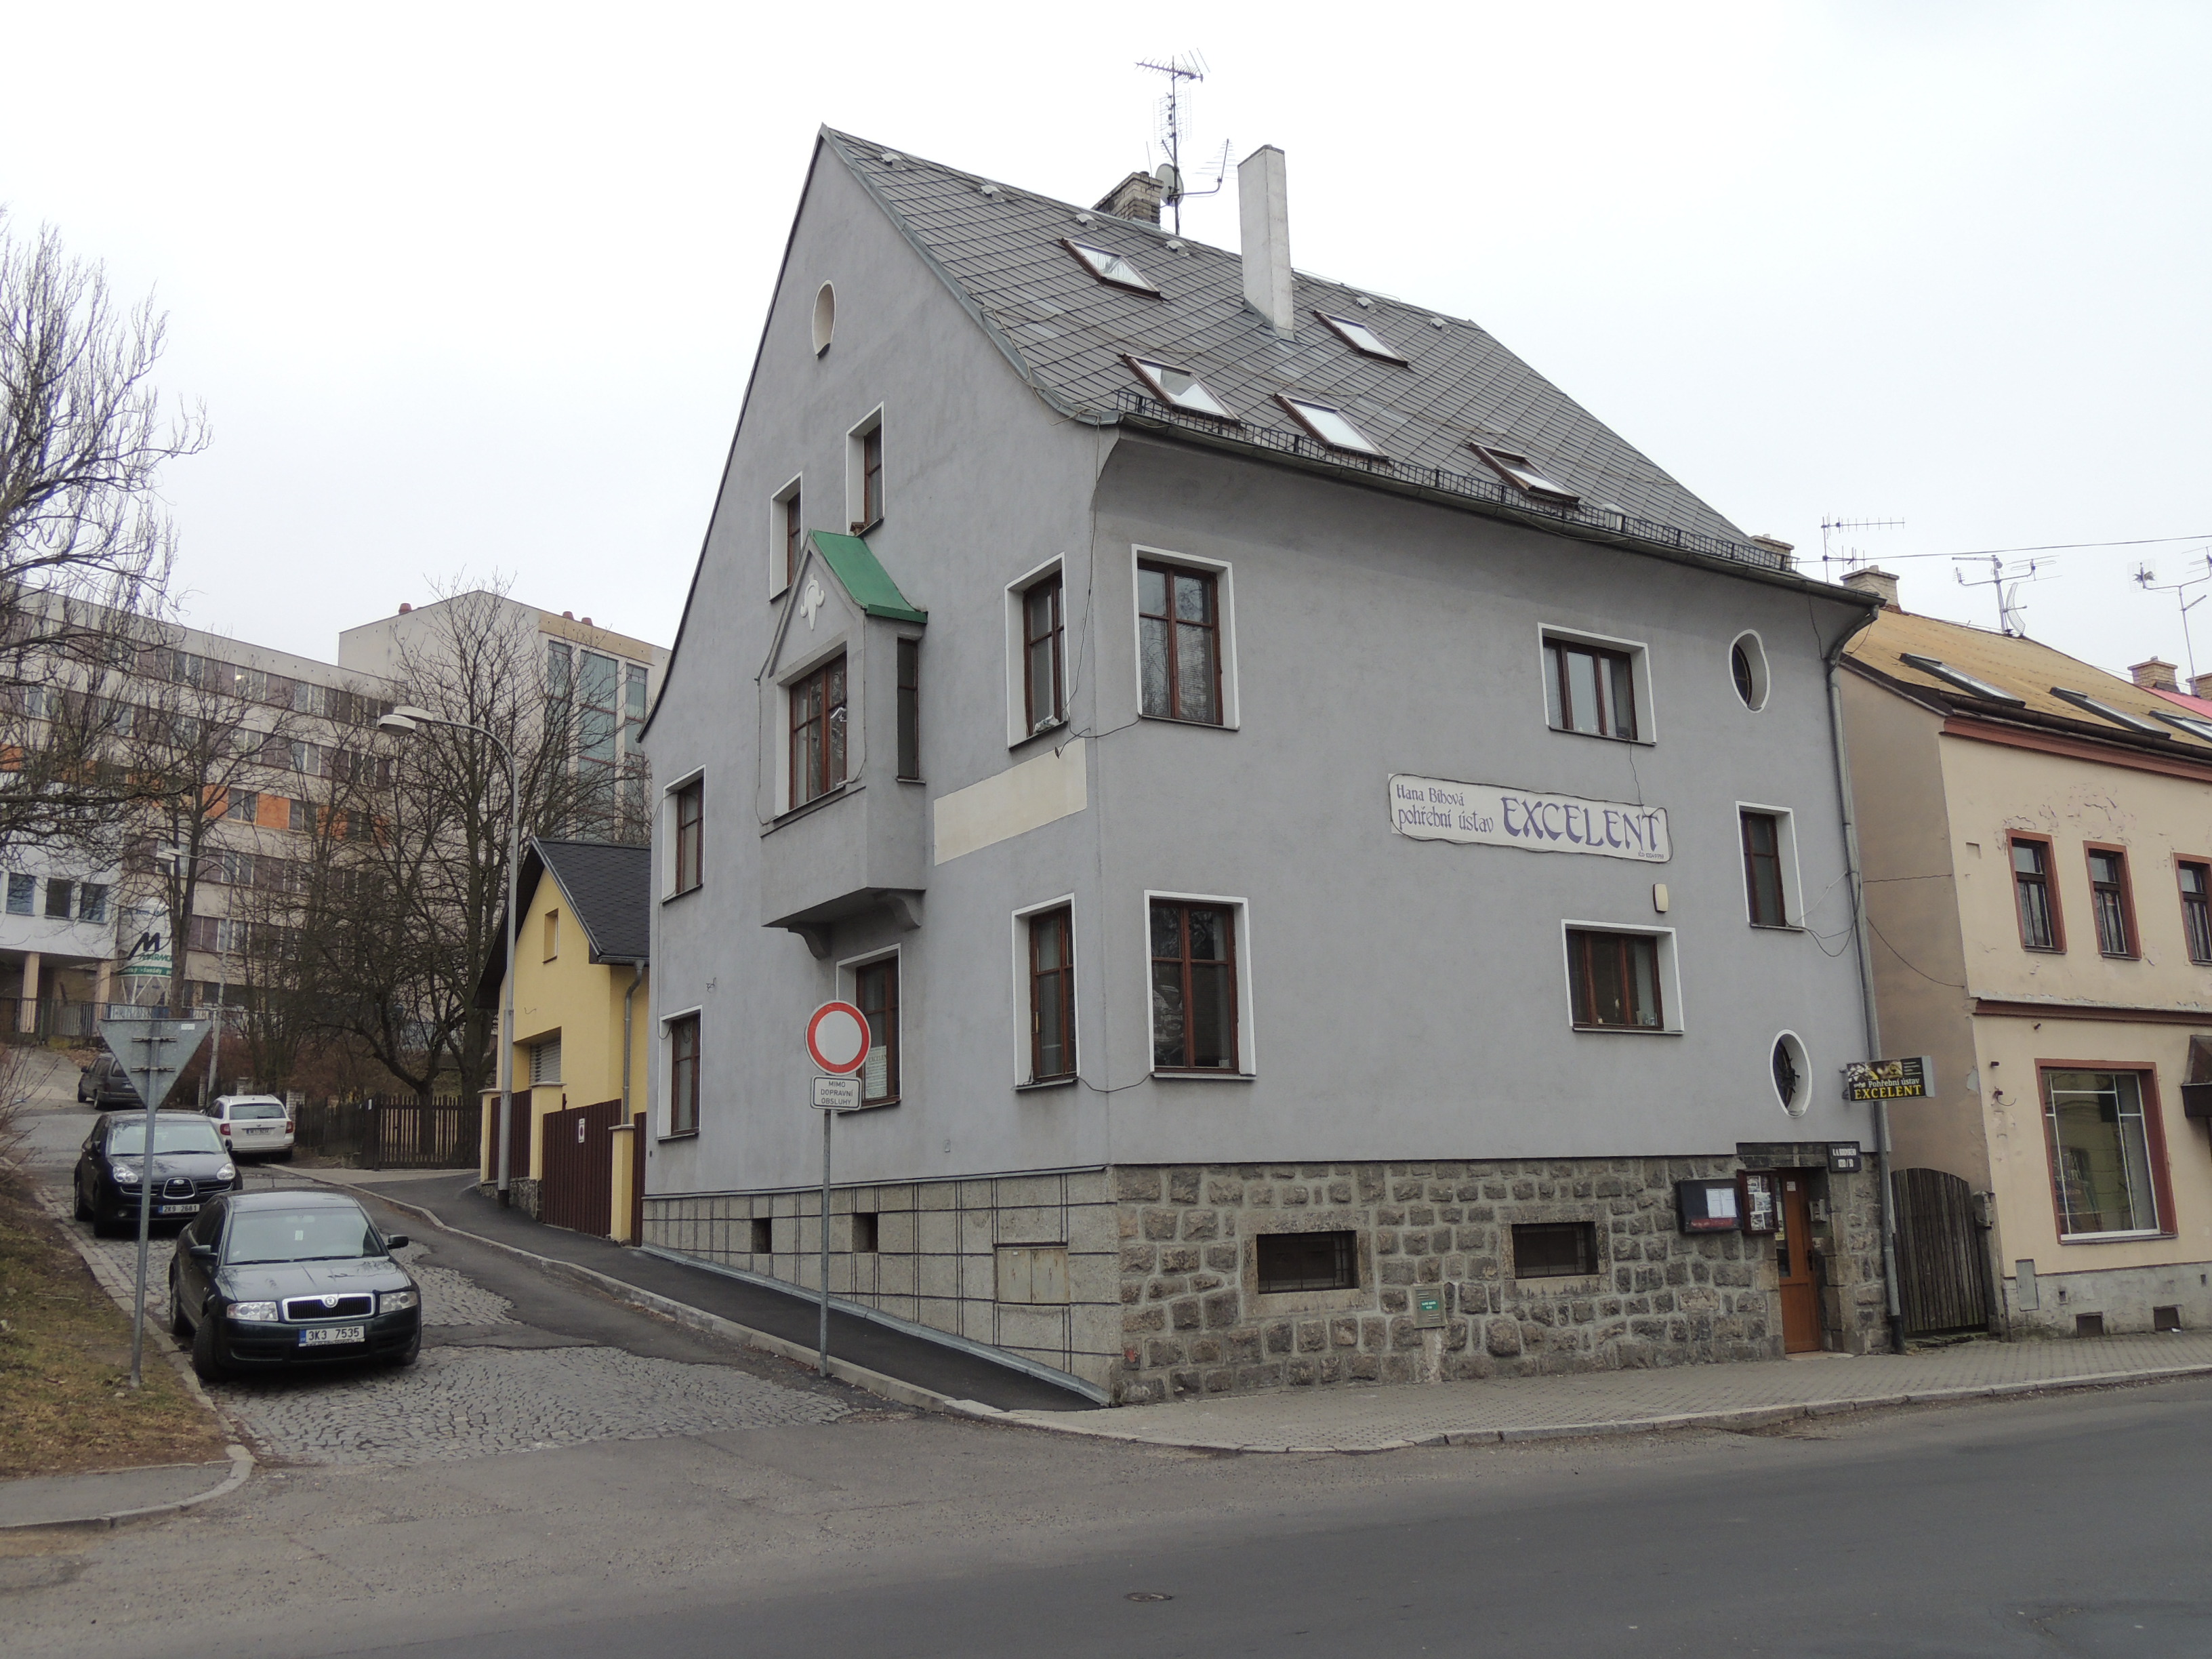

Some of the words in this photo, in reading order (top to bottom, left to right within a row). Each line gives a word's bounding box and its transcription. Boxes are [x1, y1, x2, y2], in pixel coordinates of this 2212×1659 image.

[1396, 783, 1425, 802] Hana
[1398, 804, 1452, 831] pohřební
[1458, 811, 1494, 833] ústav
[1500, 796, 1659, 852] EXCELENT
[1868, 1079, 1900, 1088] Pohřební
[821, 1088, 854, 1097] DOPRAVNÍ
[1854, 1085, 1922, 1100] EXCELENT
[821, 1097, 852, 1105] OBSLUHY
[308, 1330, 328, 1341] 3K3
[335, 1327, 360, 1340] 7535
